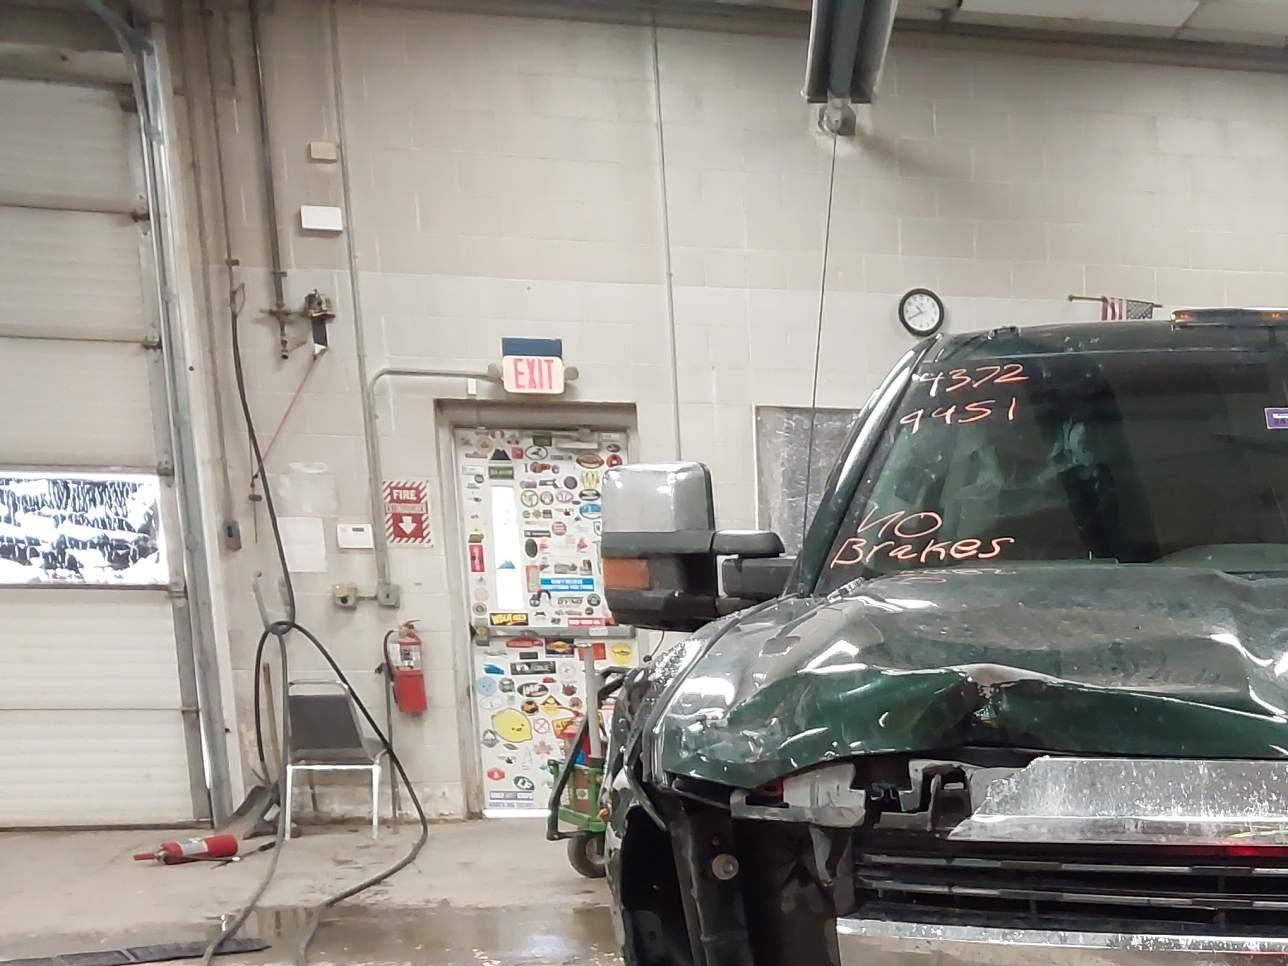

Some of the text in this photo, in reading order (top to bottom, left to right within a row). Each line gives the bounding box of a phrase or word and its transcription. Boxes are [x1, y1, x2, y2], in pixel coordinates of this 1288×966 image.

[513, 358, 554, 389] EXIT
[914, 363, 1030, 397] 4372
[899, 397, 1017, 433] 9451
[392, 489, 417, 500] FIRE
[830, 536, 1015, 568] Brakes
